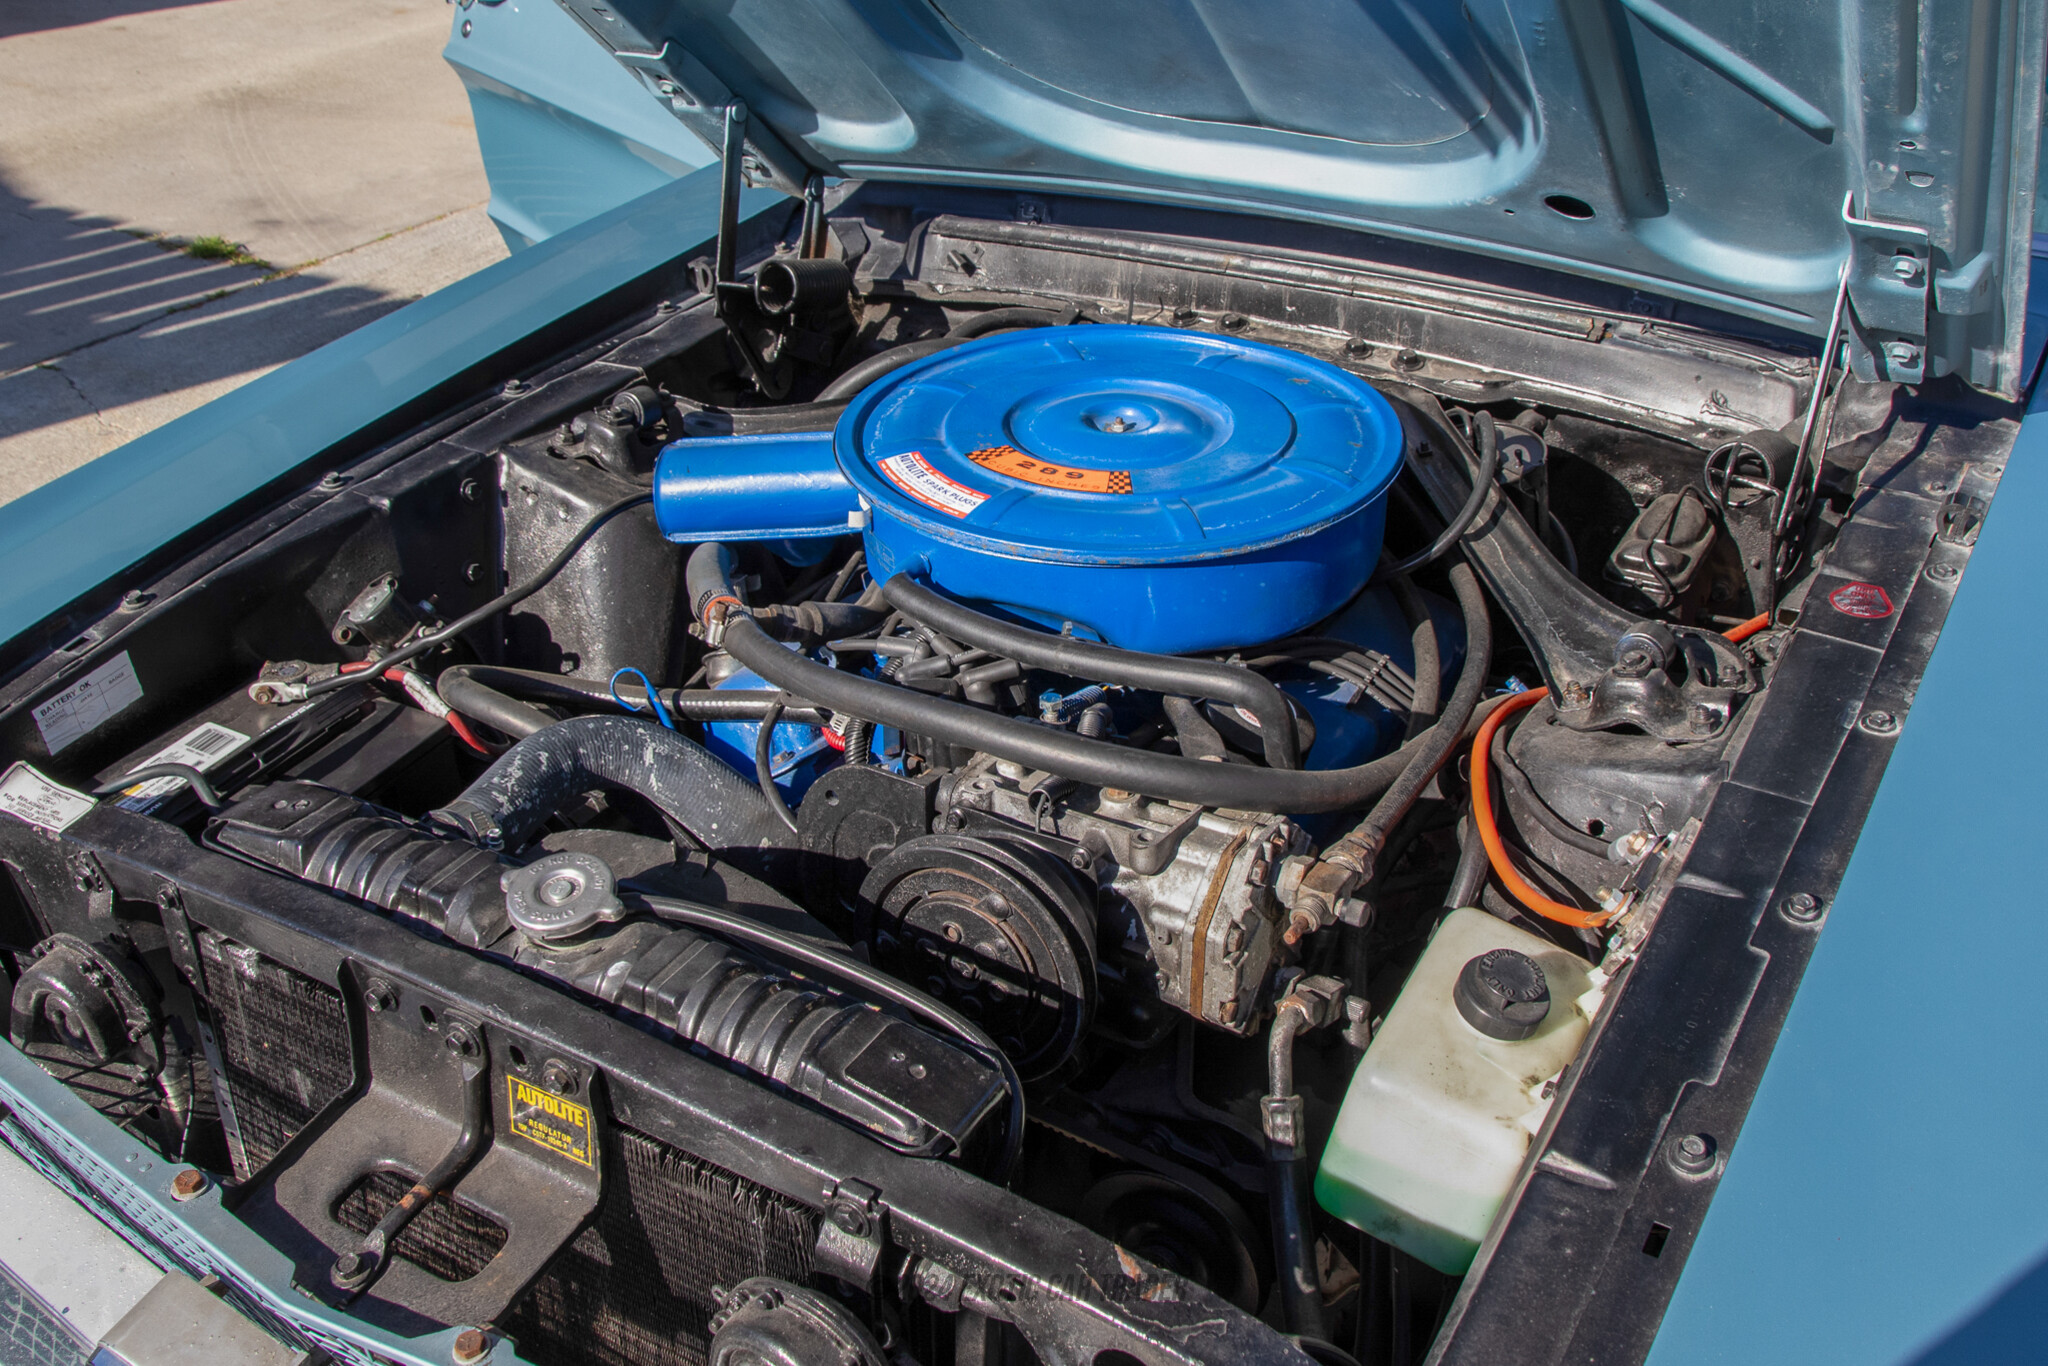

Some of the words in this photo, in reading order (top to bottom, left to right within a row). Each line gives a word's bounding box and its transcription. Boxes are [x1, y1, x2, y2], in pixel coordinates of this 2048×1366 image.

[898, 454, 928, 479] AUTOLITE
[922, 478, 949, 495] SPARK
[949, 492, 978, 507] PLUGS
[988, 460, 1029, 477] CUBIC
[1038, 476, 1100, 490] INCHES
[1016, 460, 1084, 479] 289
[40, 688, 78, 718] BATTERY
[79, 680, 92, 692] OK
[3, 792, 16, 803] FOR
[548, 855, 573, 866] NOT
[1481, 949, 1518, 970] ENGINE
[1486, 976, 1516, 999] ONLY
[517, 1083, 584, 1128] AUTOLITE
[528, 1118, 572, 1145] REGULATOR
